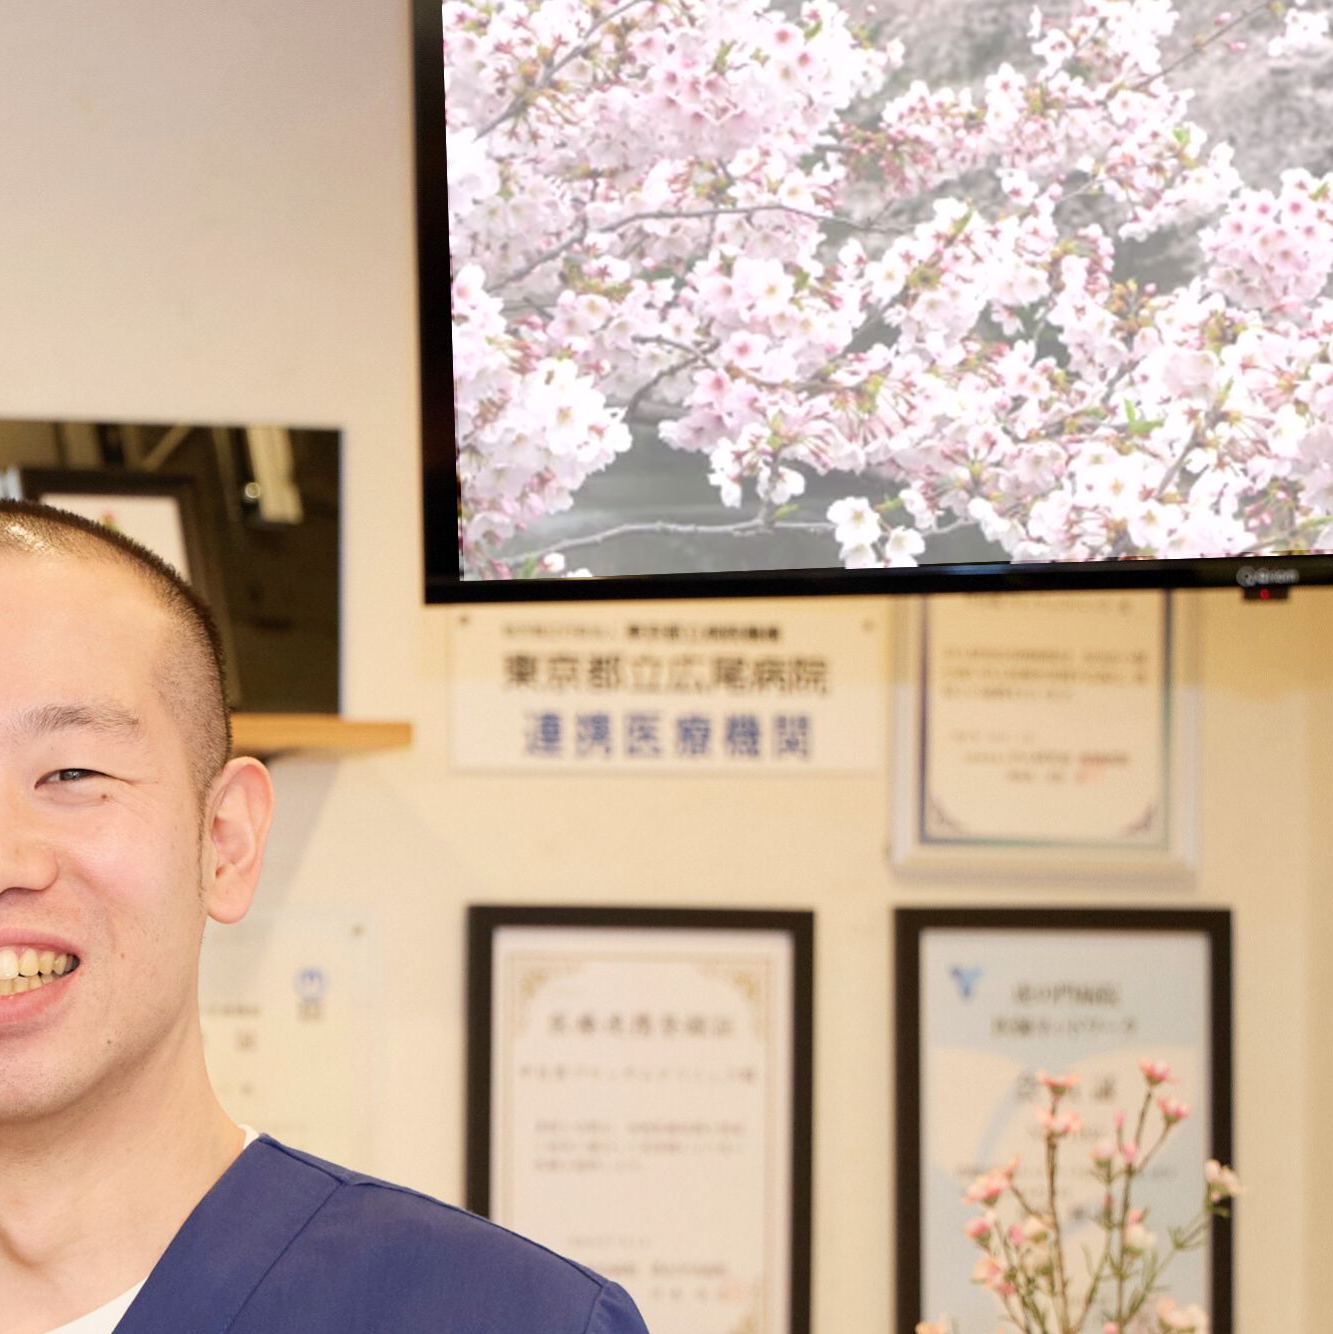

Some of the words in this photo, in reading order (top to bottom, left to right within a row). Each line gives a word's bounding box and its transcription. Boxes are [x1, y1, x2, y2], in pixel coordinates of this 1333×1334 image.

[524, 711, 812, 759] 連携医療機関
